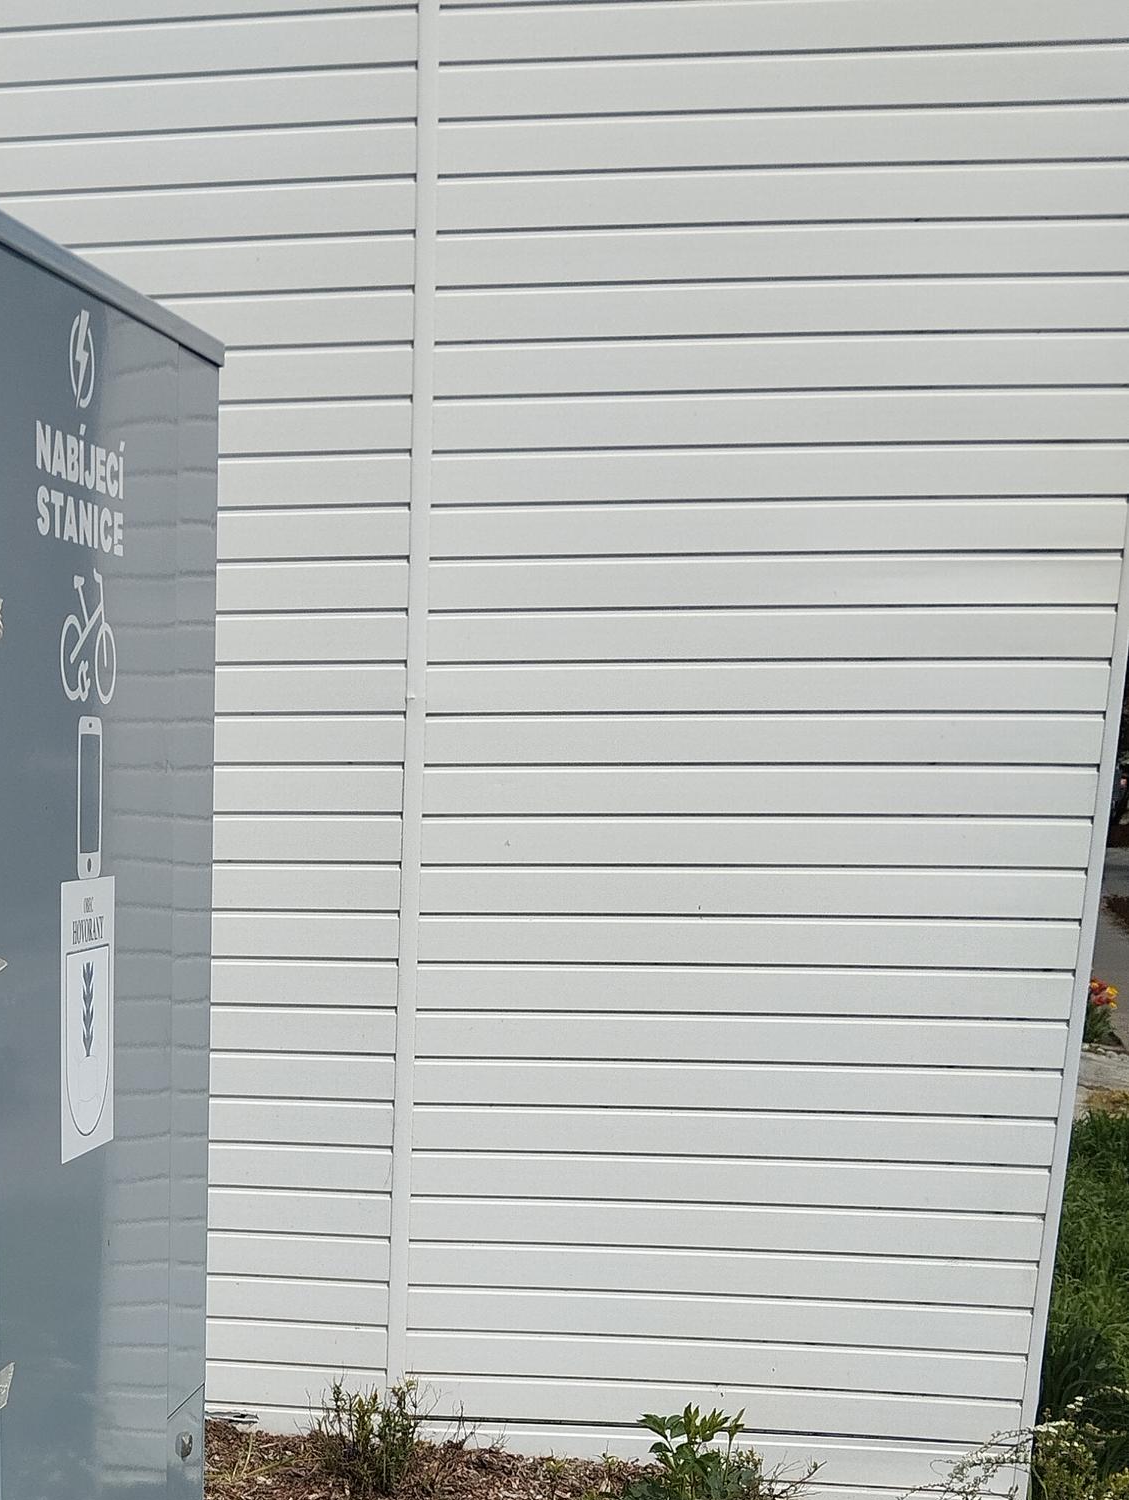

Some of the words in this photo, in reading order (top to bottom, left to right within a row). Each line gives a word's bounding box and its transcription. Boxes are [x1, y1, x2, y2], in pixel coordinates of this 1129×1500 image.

[35, 419, 125, 499] NABÍJECÍ
[35, 488, 125, 557] STANICE
[72, 915, 104, 945] HOVORANY
